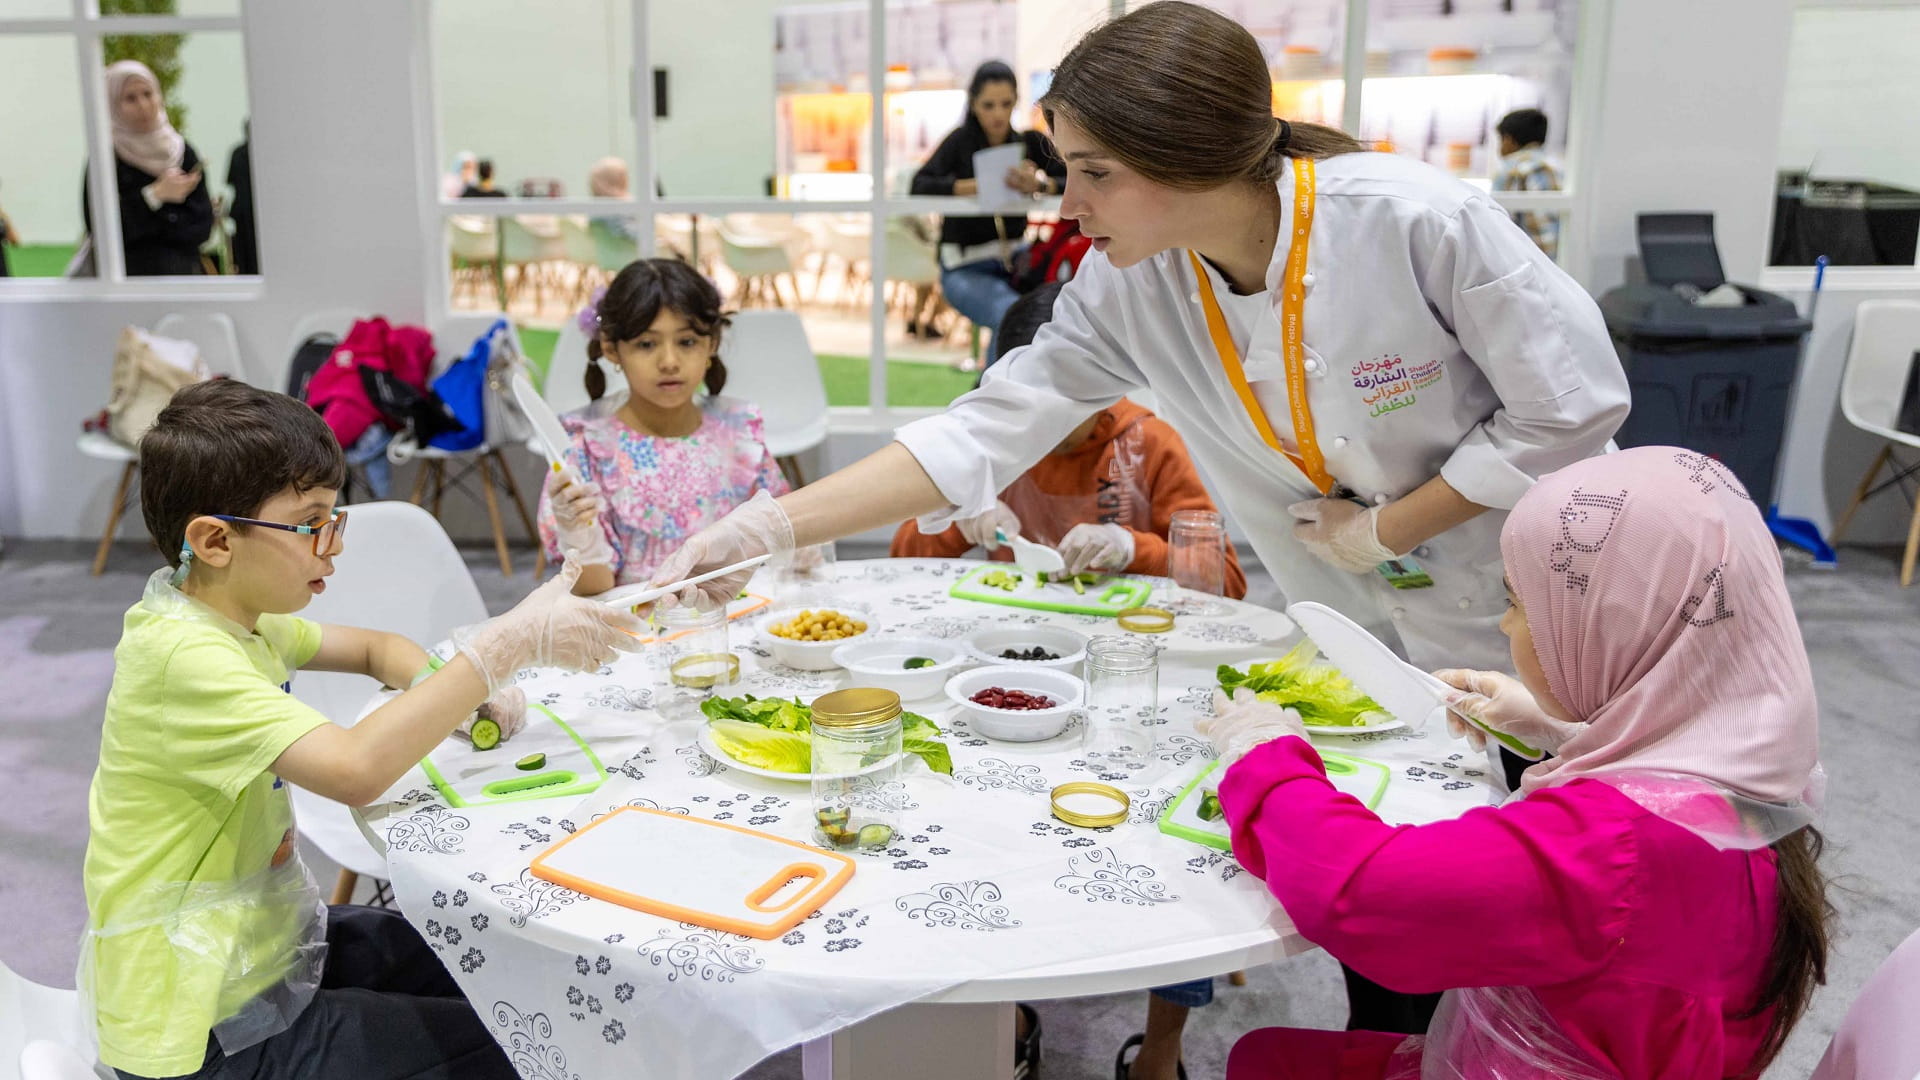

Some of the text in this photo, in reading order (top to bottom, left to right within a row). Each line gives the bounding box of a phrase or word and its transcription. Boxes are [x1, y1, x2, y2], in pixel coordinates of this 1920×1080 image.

[1288, 313, 1297, 344] Festival
[1289, 345, 1298, 374] Reading
[1408, 359, 1437, 373] Sharjah
[1411, 361, 1444, 380] Children'
